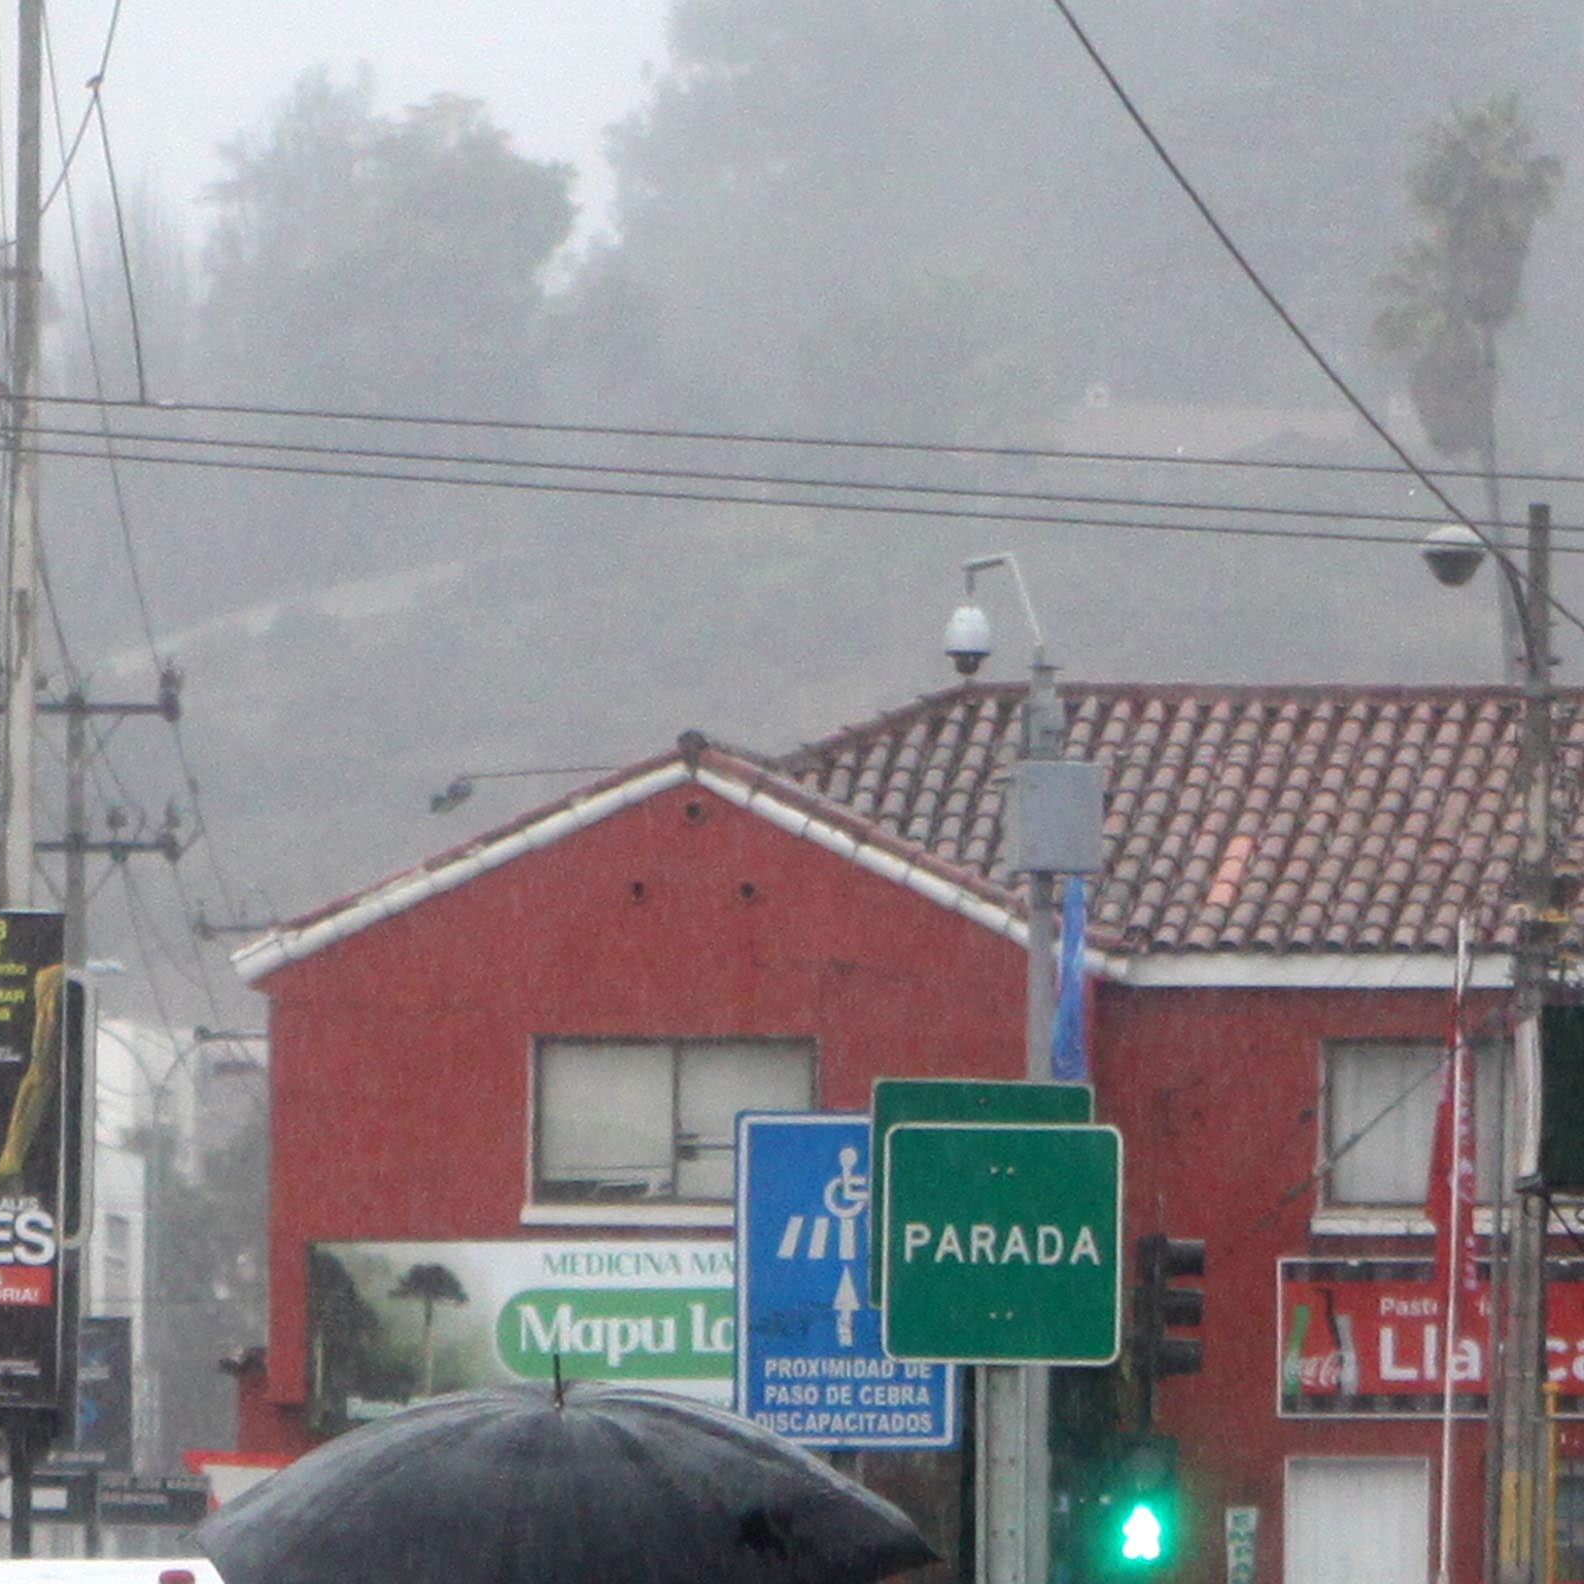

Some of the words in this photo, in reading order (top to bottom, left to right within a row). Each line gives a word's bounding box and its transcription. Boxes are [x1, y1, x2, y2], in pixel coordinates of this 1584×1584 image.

[902, 1224, 1100, 1265] PARADA
[542, 1252, 682, 1276] MEDICINA
[515, 1302, 677, 1368] Mapu
[765, 1358, 894, 1379] PROXIMIDAD
[905, 1360, 933, 1379] DE
[765, 1384, 819, 1405] PASO
[826, 1385, 852, 1406] DE
[859, 1385, 931, 1406] CEBRA
[754, 1412, 933, 1434] DISCAPACITADOS
